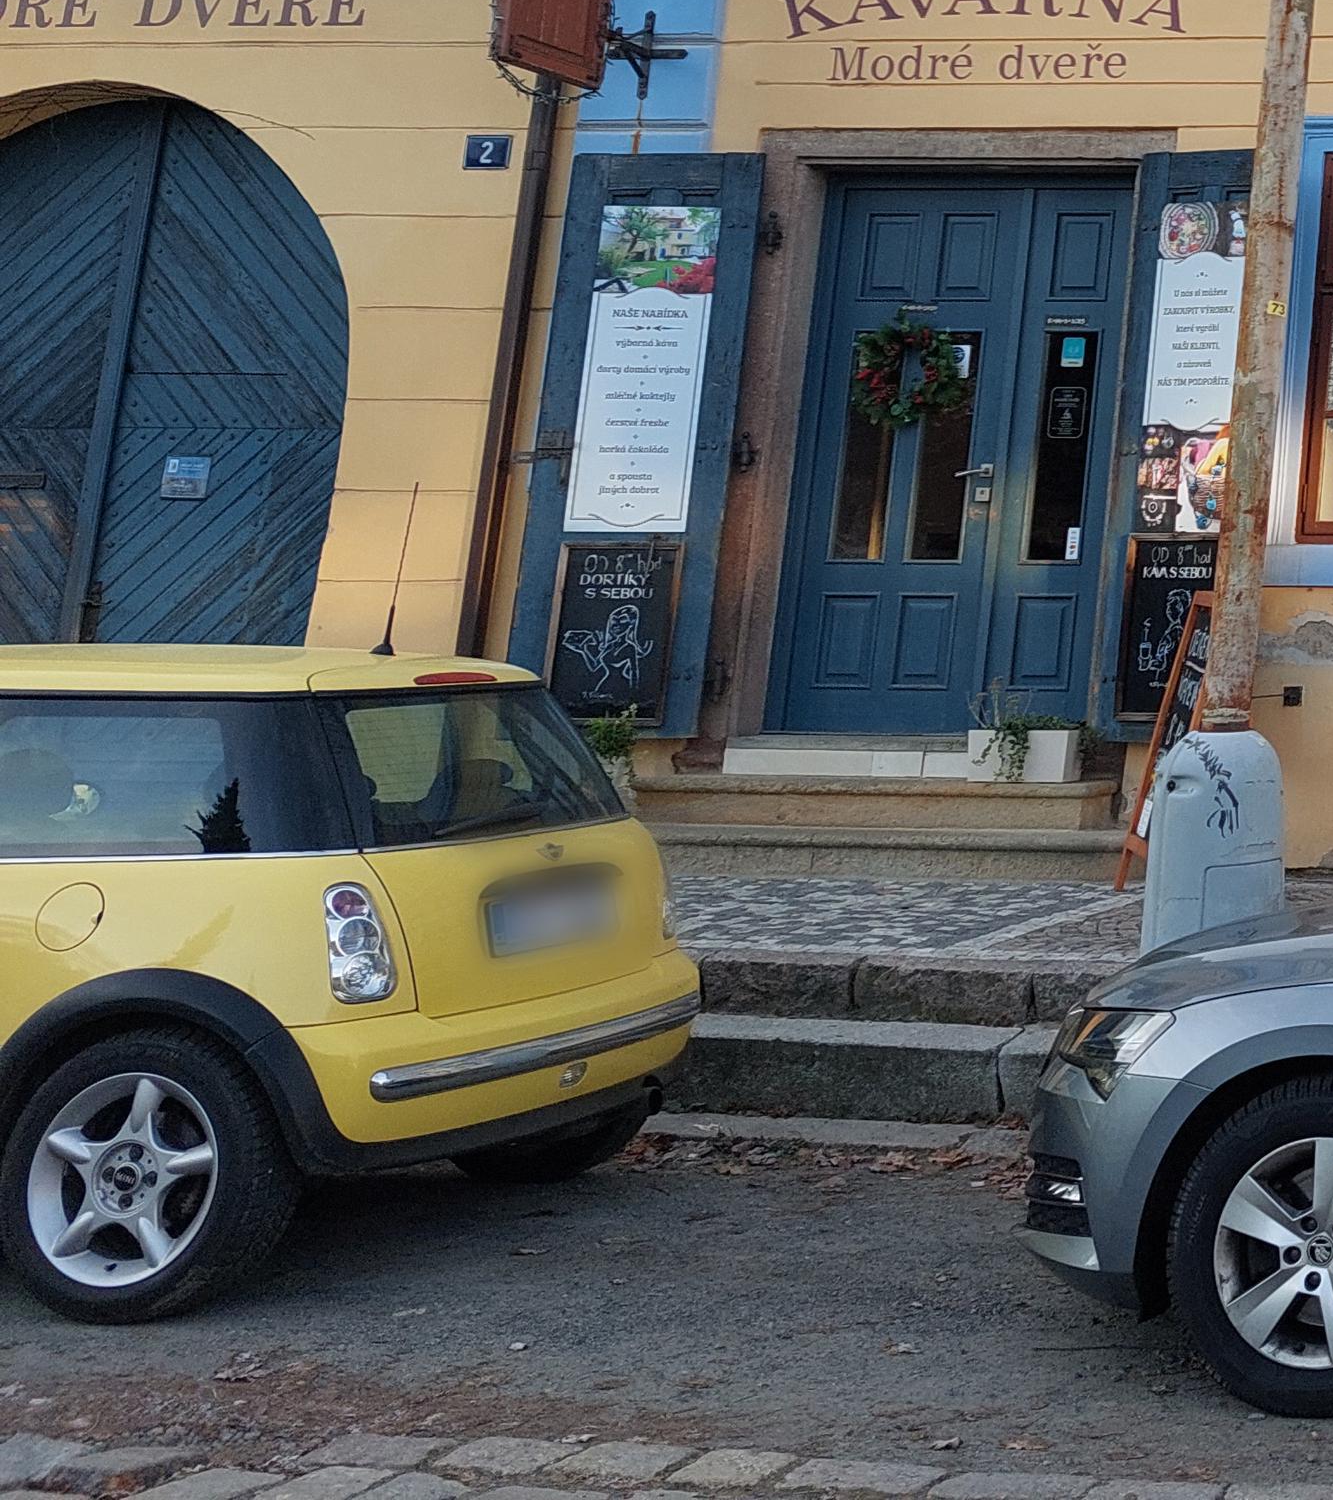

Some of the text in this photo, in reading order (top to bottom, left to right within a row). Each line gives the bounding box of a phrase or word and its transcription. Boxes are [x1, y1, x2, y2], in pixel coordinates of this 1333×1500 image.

[826, 43, 1128, 82] Modré dveře
[480, 141, 493, 164] 2
[612, 308, 688, 318] NAŠE NABÍDKA
[1272, 302, 1285, 315] 73
[616, 338, 678, 348] výborná káva
[623, 365, 656, 373] domácí
[659, 366, 690, 375] výroby
[1157, 377, 1172, 387] NÁS
[605, 391, 676, 402] mléčné koktejly
[605, 418, 669, 427] čerstvé freshe
[599, 444, 669, 454] horká čokoláda
[617, 474, 652, 482] spousta
[598, 486, 660, 495] jiných dobrot
[1178, 566, 1212, 578] SEBOU
[579, 569, 650, 586] DORTÍKY
[584, 588, 653, 599] S SEBOU
